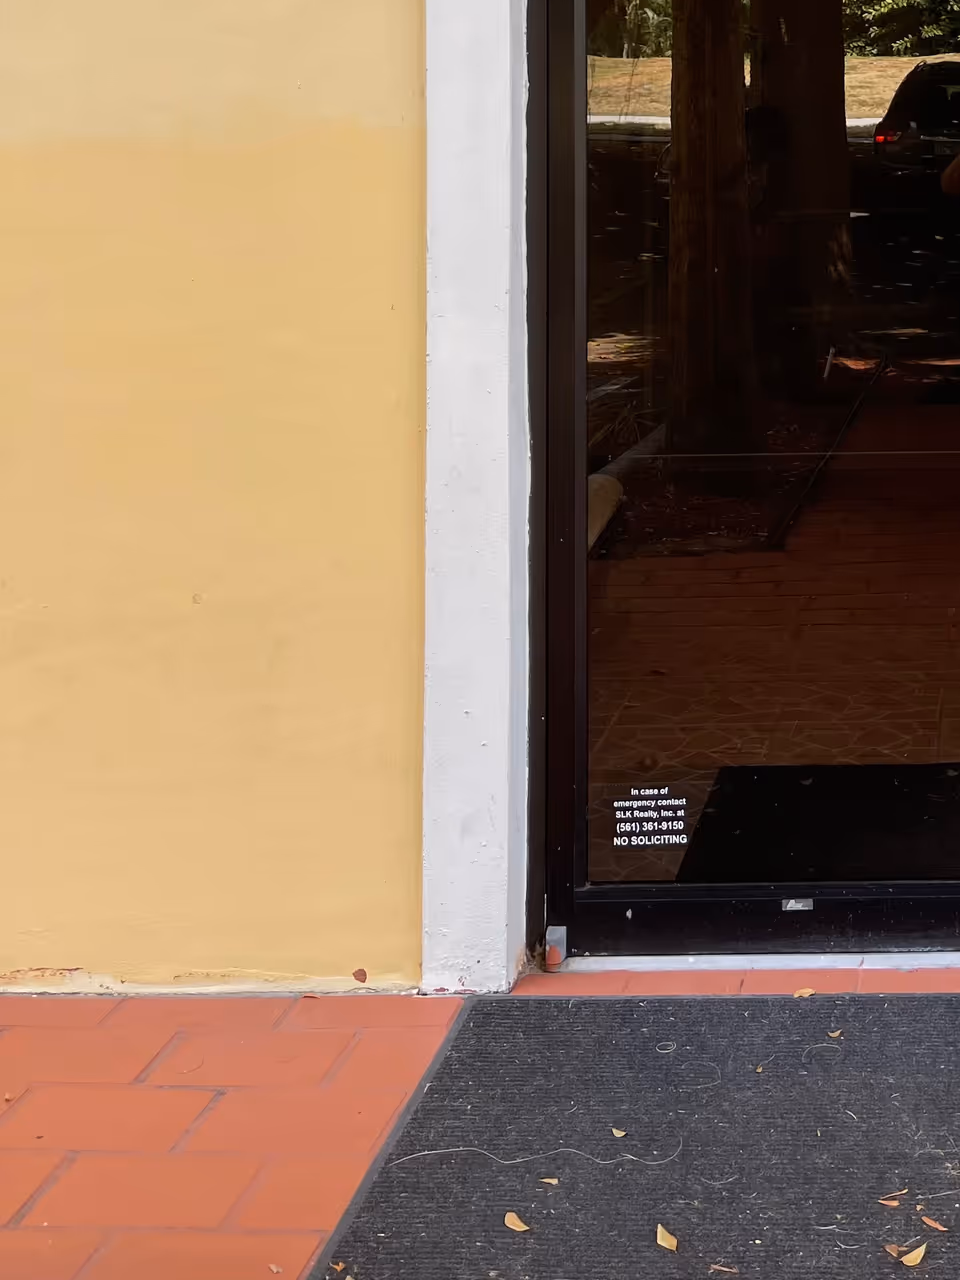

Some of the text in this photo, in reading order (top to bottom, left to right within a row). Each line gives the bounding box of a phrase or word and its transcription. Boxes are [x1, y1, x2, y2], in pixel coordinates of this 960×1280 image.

[613, 800, 656, 808] emergency
[634, 810, 659, 818] Realty,
[617, 821, 683, 833] (561) 361-9150
[614, 835, 687, 846] NO SOLICITING
